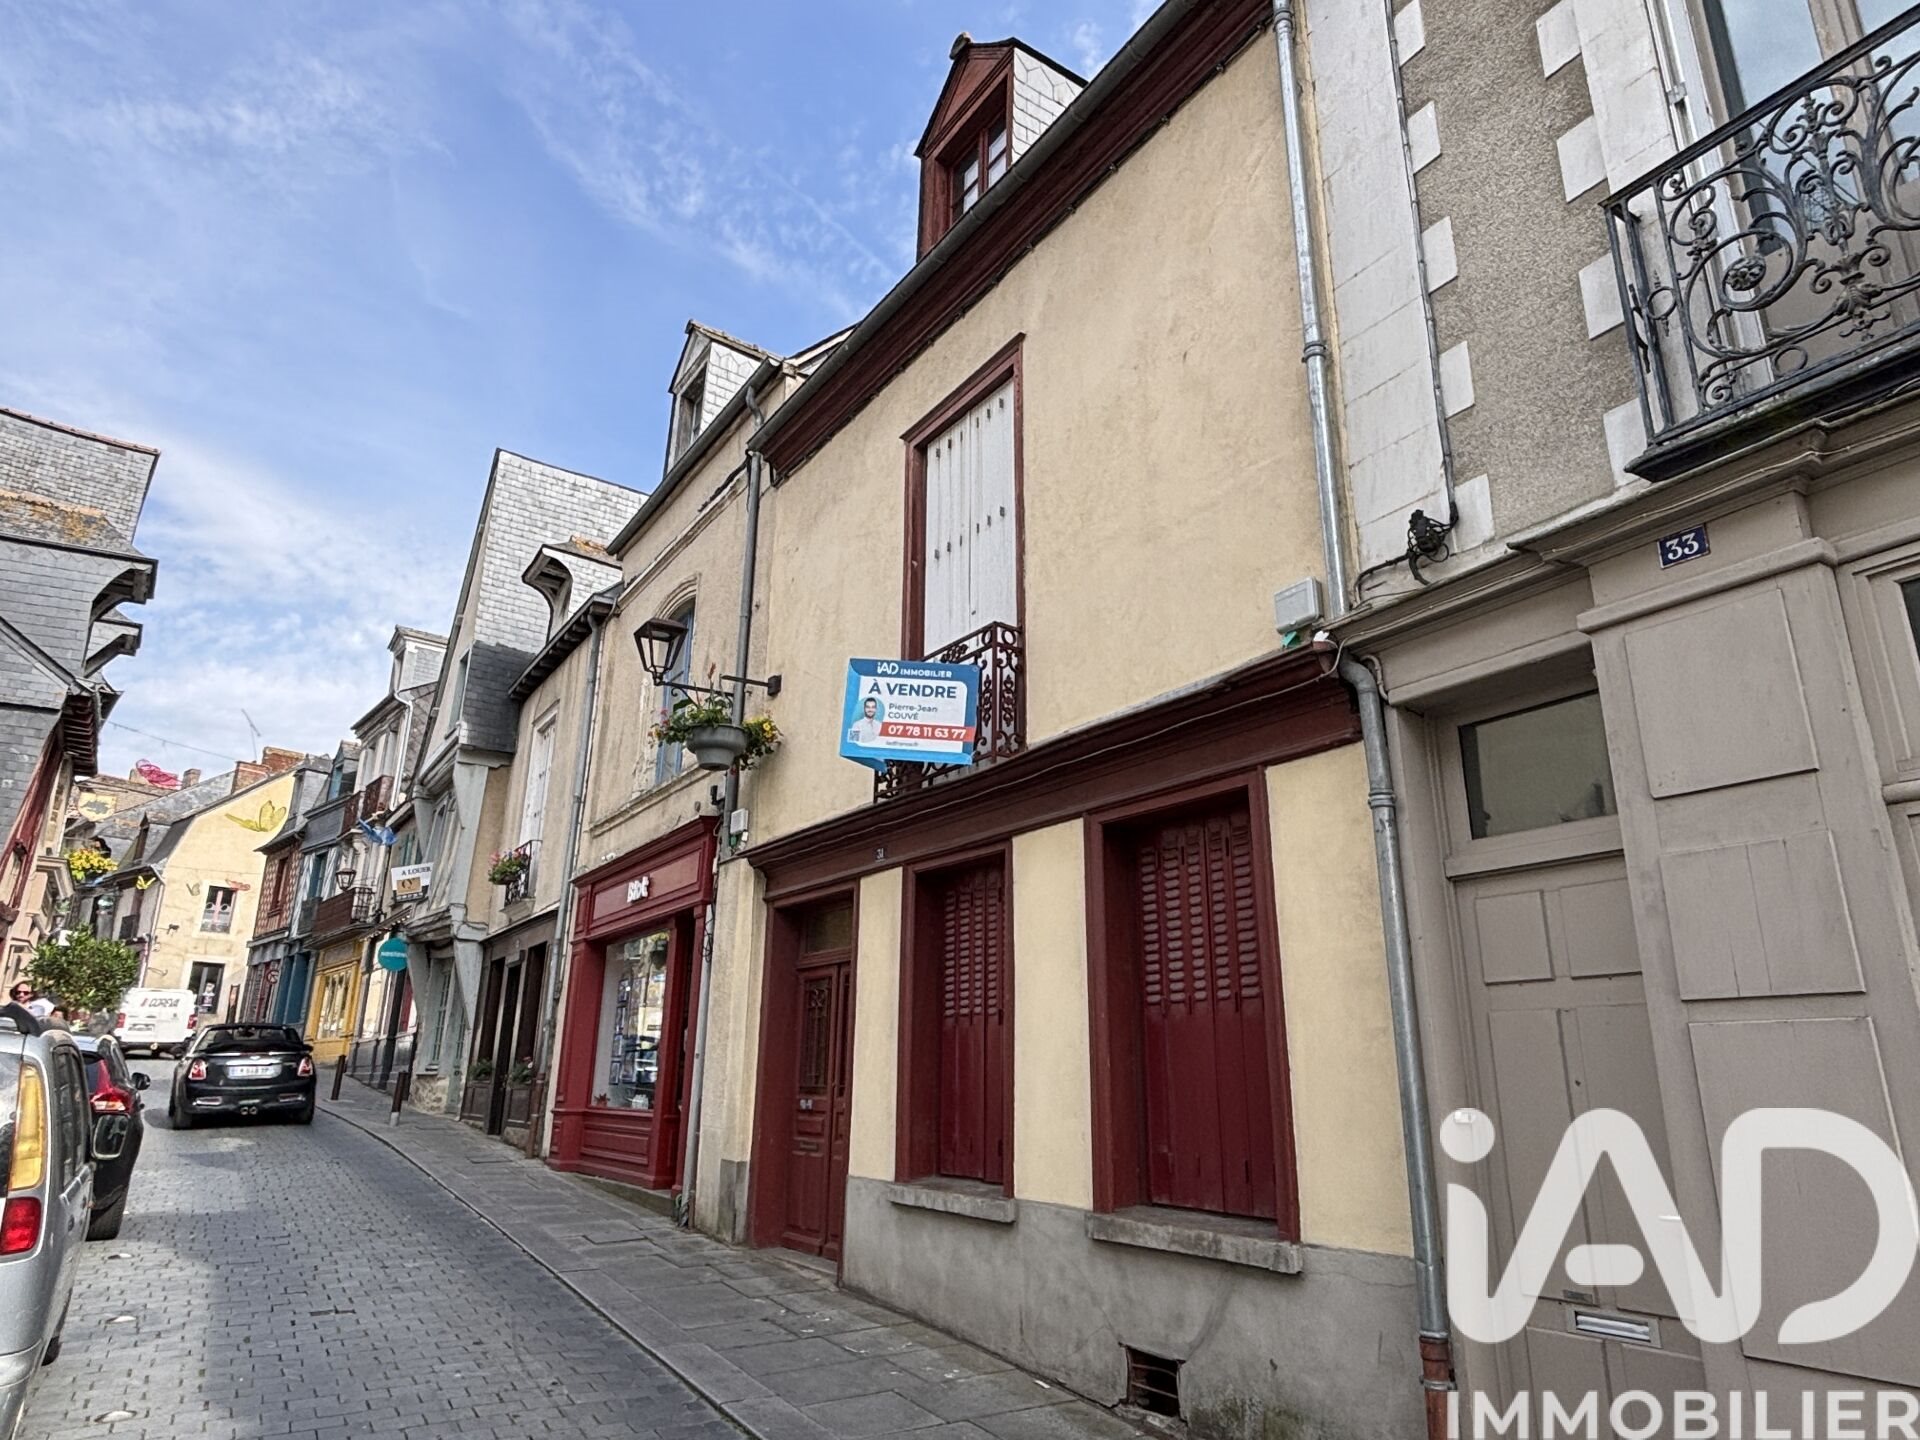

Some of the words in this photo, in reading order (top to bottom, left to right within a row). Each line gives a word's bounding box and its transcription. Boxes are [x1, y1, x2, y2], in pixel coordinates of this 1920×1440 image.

[1666, 532, 1699, 560] 33
[900, 669, 952, 678] IMMOBILIER
[869, 679, 882, 694] À
[886, 682, 957, 699] VENDRE
[888, 703, 938, 713] Pierre-Jean
[888, 711, 919, 721] COUVÉ
[888, 725, 903, 736] 07
[905, 726, 920, 736] 78
[923, 727, 932, 737] 11
[934, 727, 949, 738] 63
[951, 729, 967, 740] 77
